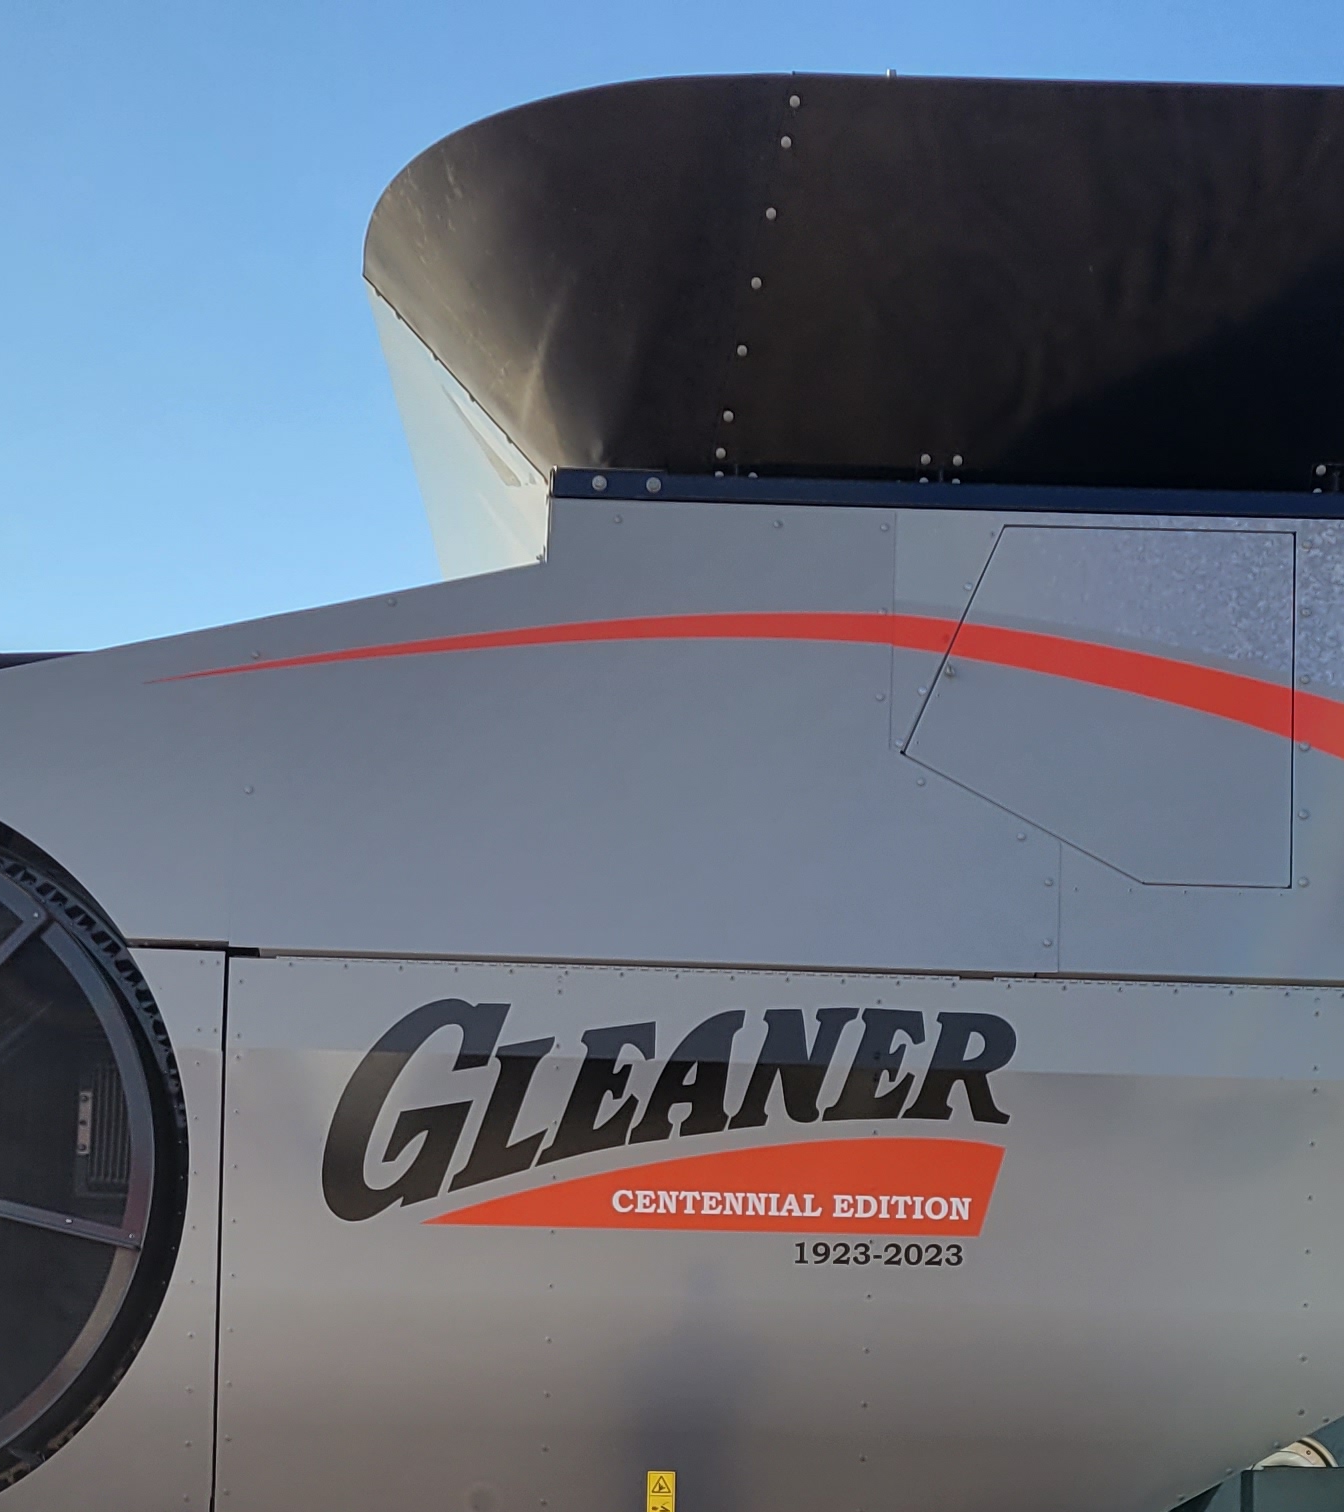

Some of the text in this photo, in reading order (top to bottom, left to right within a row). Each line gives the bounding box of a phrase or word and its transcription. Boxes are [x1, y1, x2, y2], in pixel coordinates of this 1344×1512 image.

[321, 998, 1017, 1222] GLEANER
[611, 1189, 972, 1222] CENTENNIAL EDITION
[793, 1241, 965, 1267] 1923-2023
